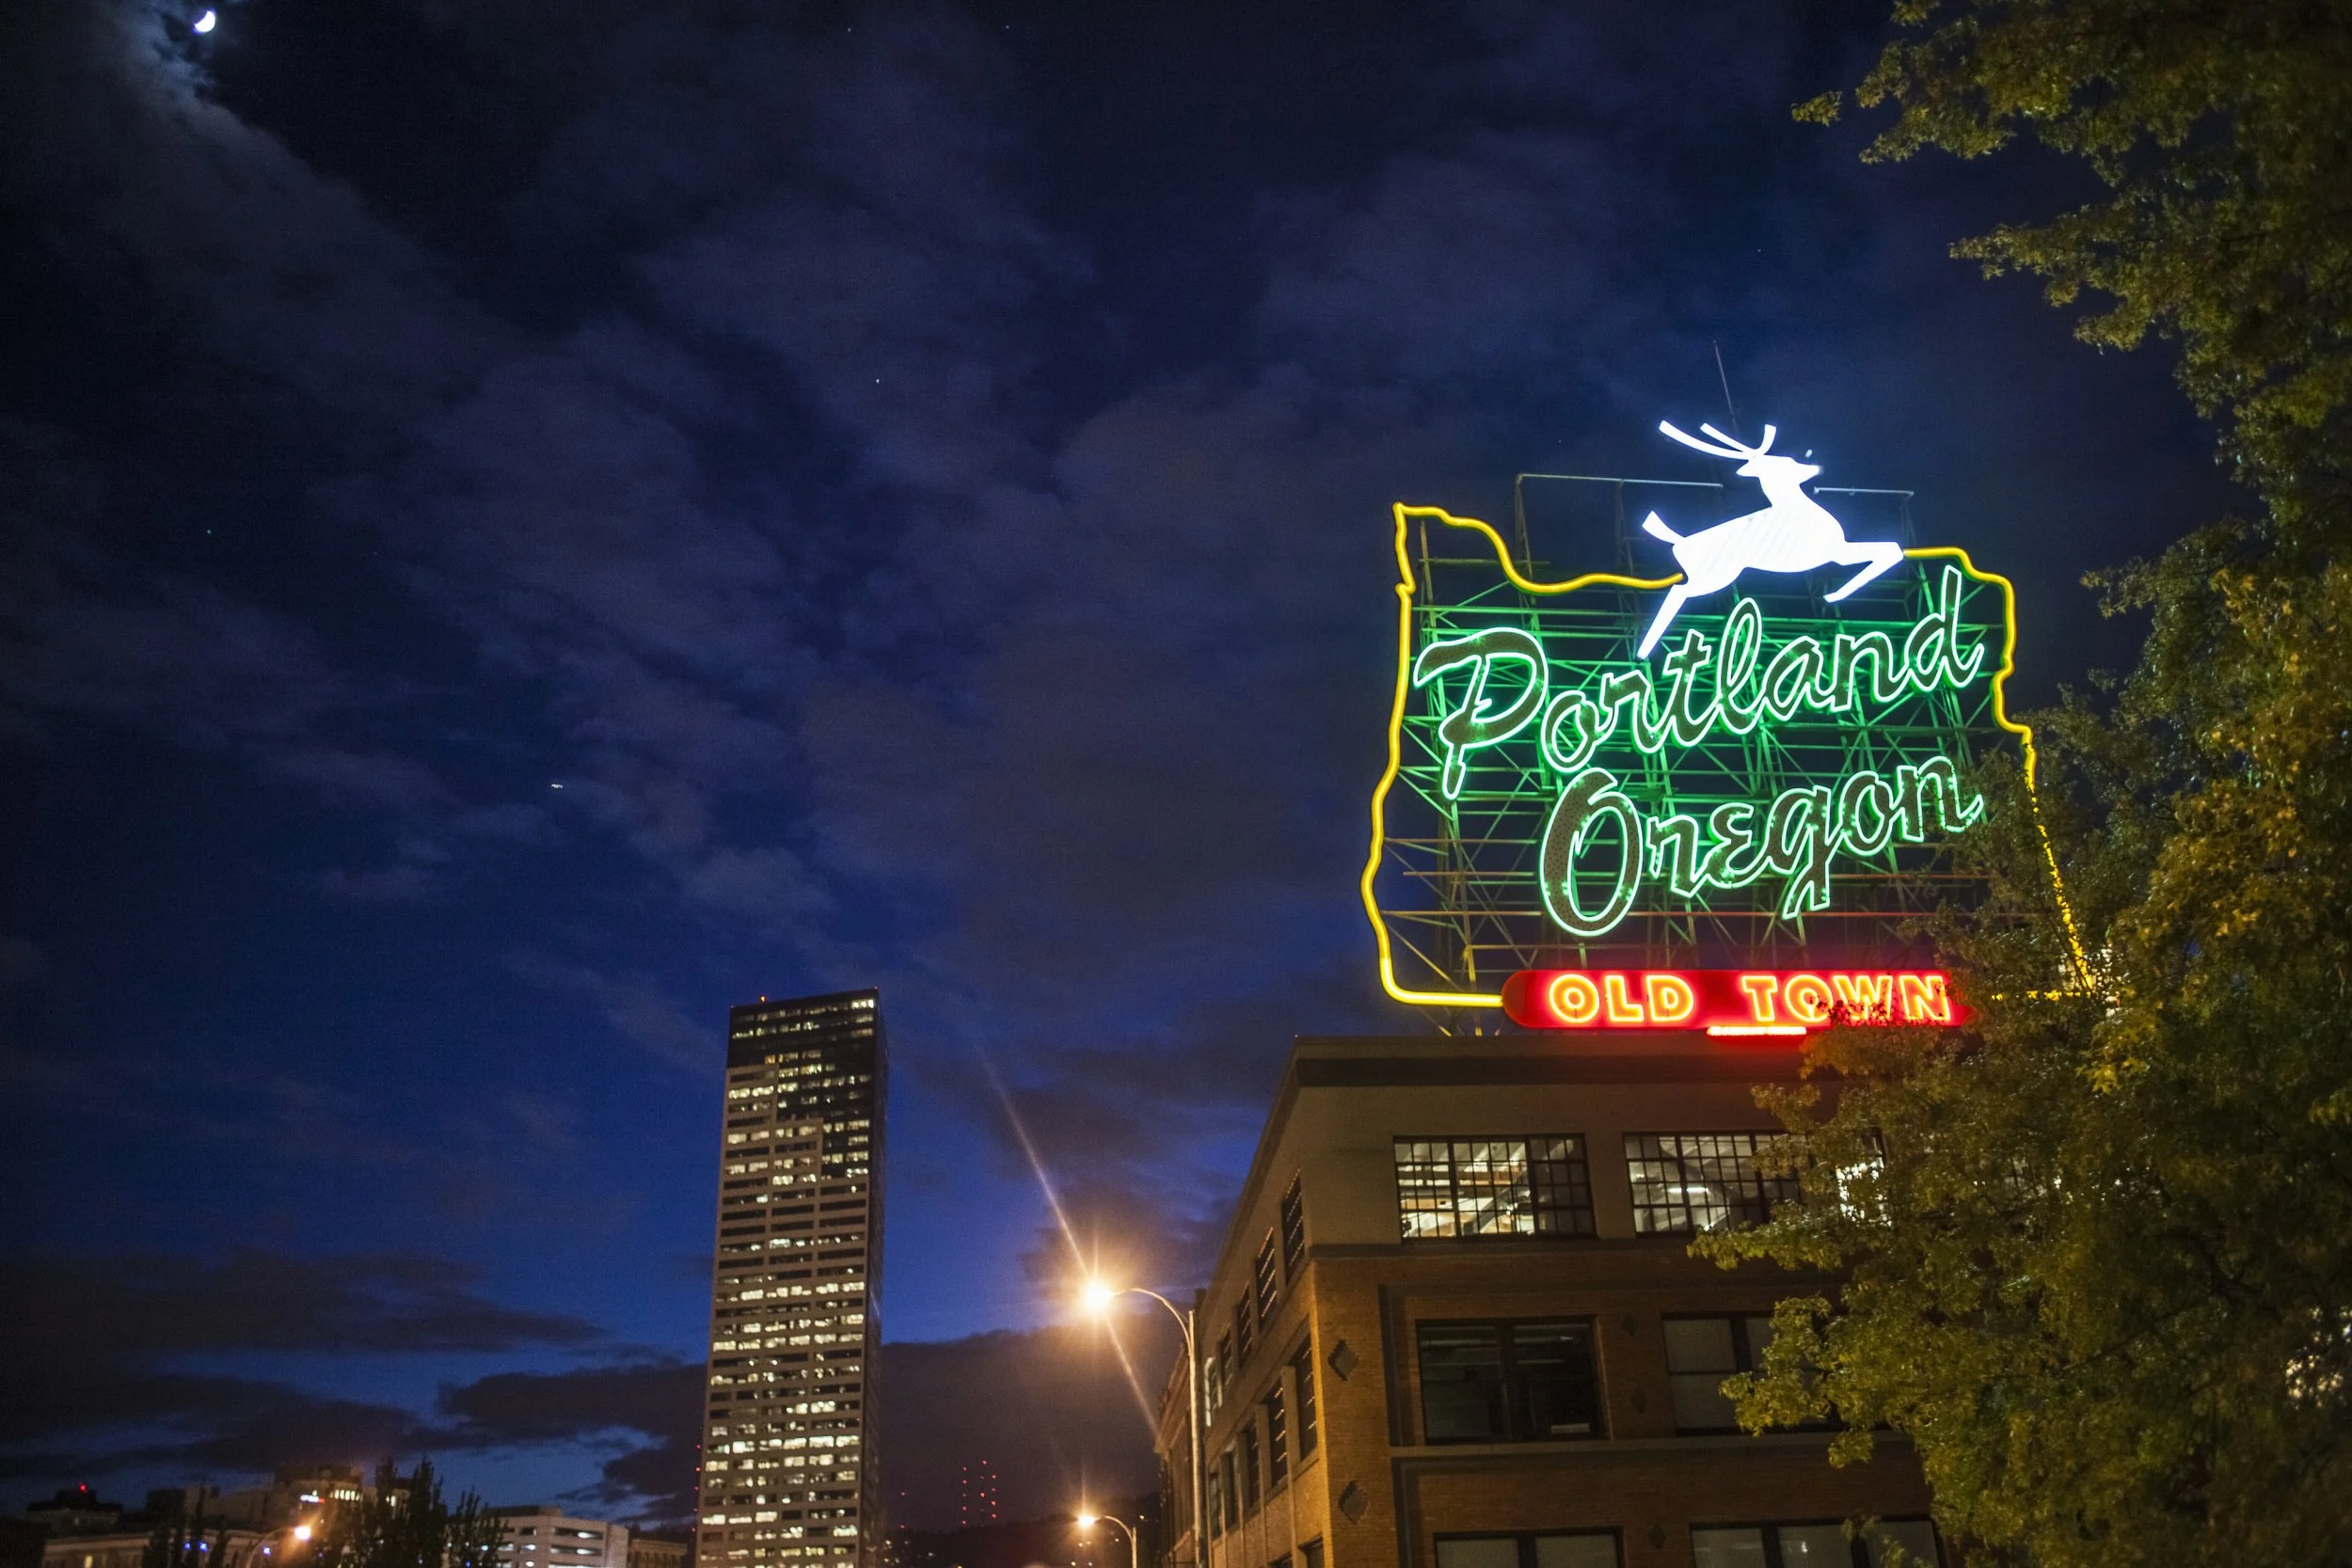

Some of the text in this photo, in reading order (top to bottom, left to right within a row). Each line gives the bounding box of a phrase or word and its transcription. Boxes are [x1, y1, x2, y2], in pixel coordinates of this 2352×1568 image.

[1412, 564, 1985, 800] Portland
[1539, 754, 1984, 937] Oregon
[1548, 974, 1952, 1024] OLD TOWN
